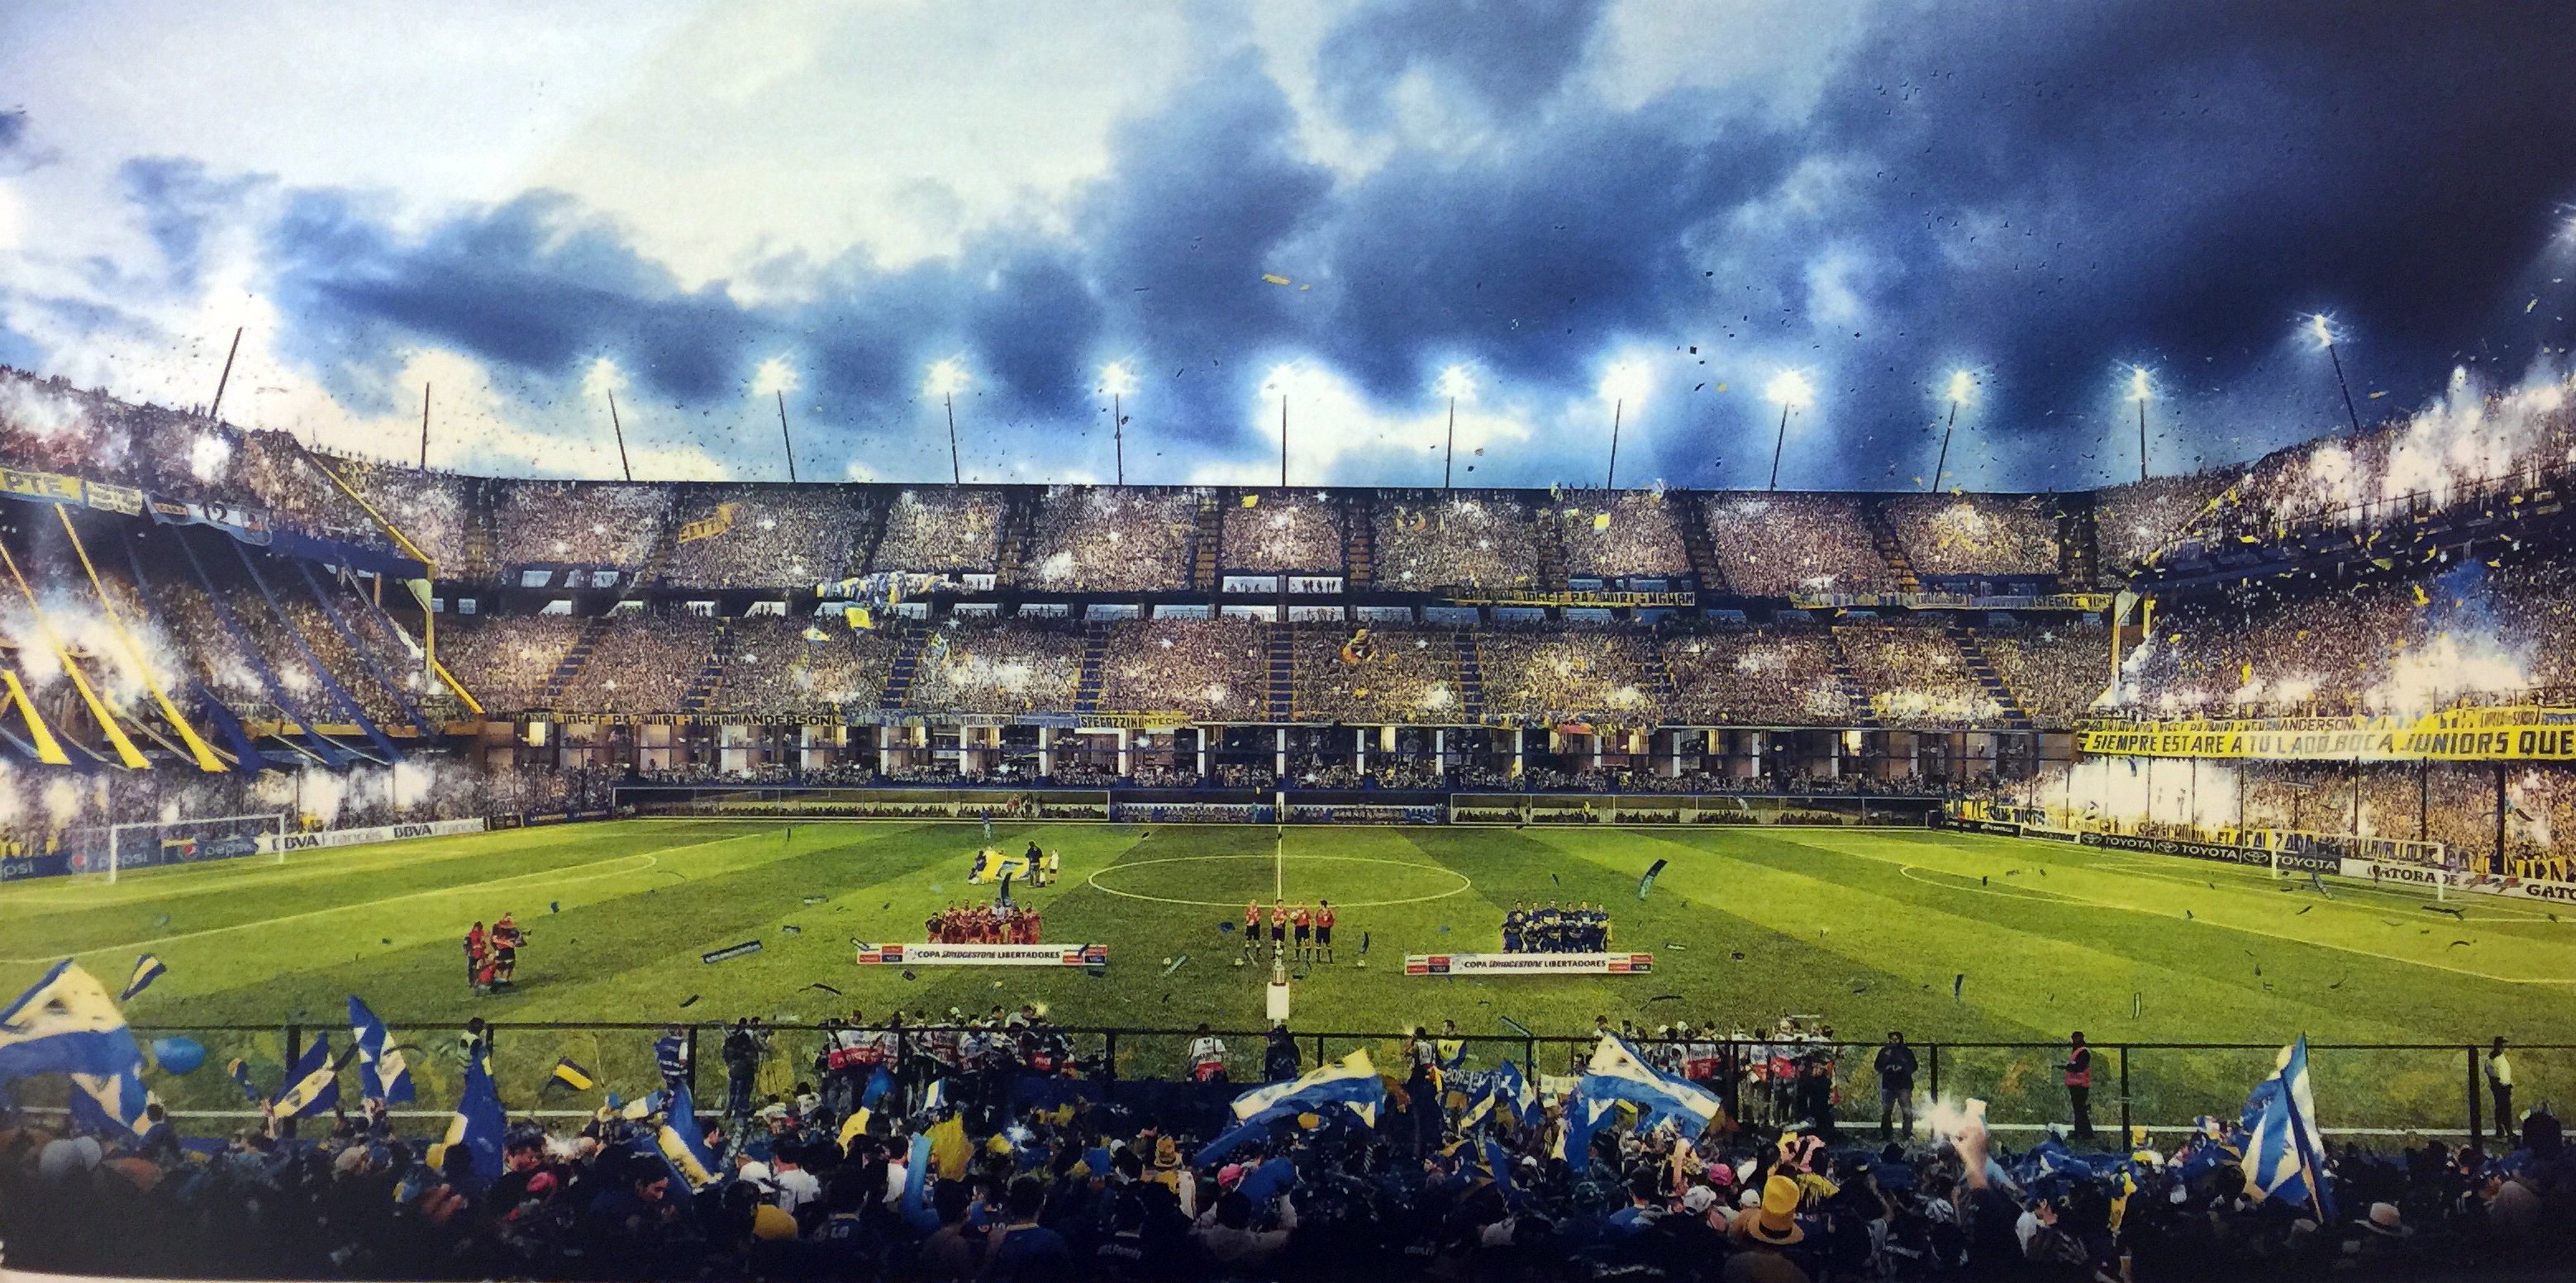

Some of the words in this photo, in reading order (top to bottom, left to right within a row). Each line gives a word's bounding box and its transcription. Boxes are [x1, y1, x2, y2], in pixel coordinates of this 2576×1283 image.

[744, 715, 832, 725] ANDERSON
[1080, 715, 1143, 729] SPEGAZZINI
[2093, 734, 2158, 752] SIEMPRE
[2231, 736, 2243, 753] A
[2400, 731, 2510, 754] JUNIORS
[2518, 730, 2575, 755] QUE
[393, 824, 432, 839] BBVA
[2106, 837, 2152, 848] TOYOTA
[2182, 844, 2238, 859] TOYOTA
[2276, 854, 2338, 871] TOYOTA
